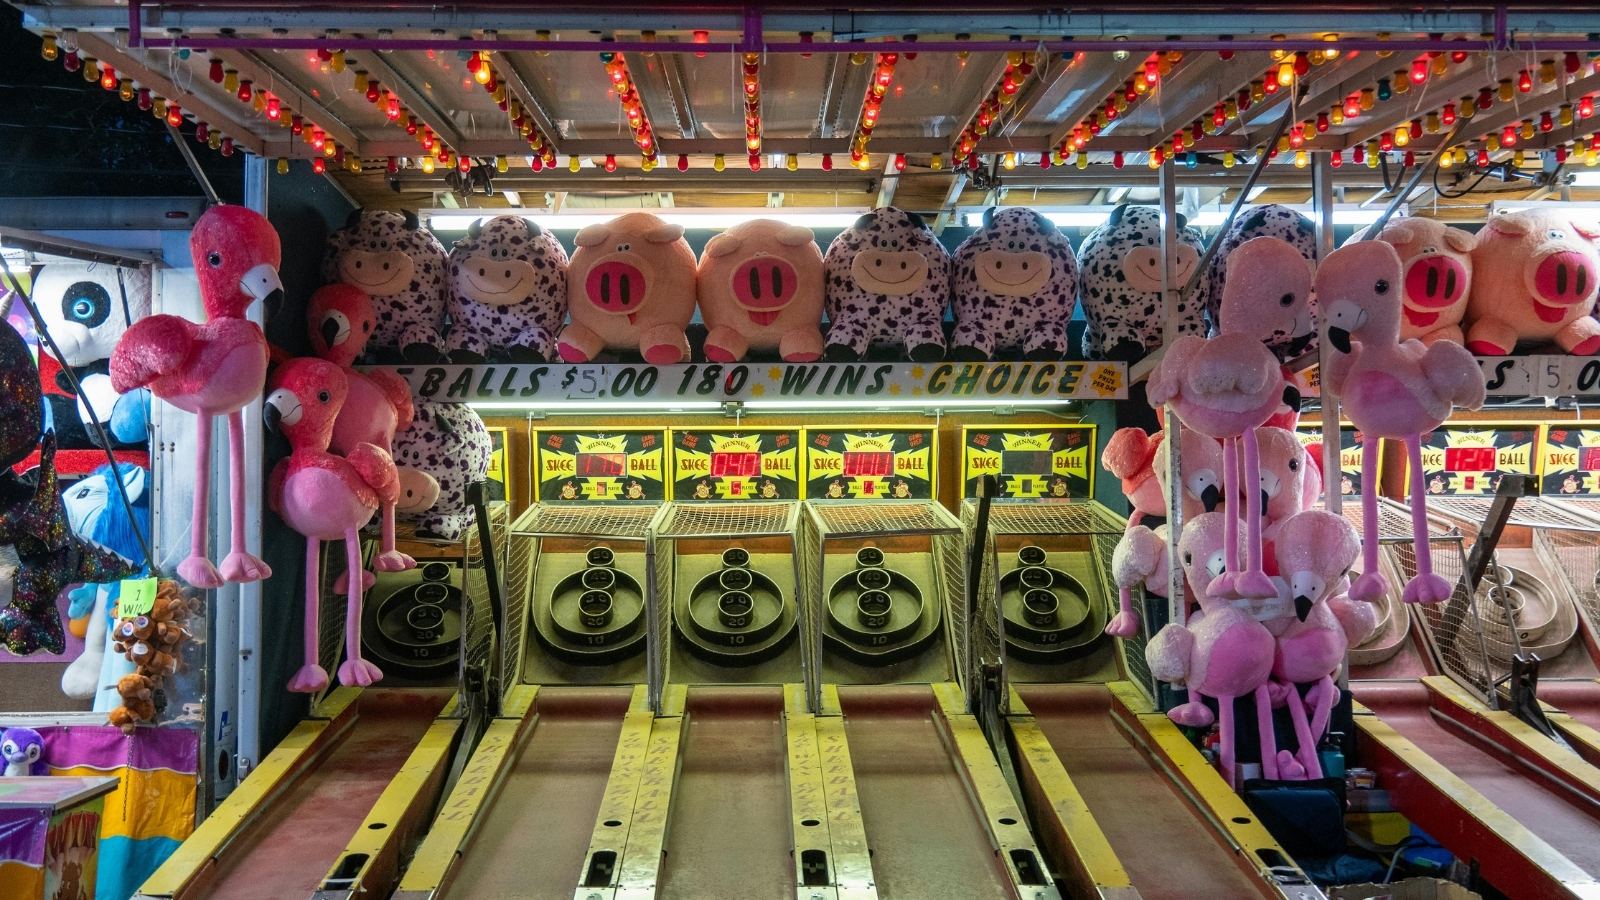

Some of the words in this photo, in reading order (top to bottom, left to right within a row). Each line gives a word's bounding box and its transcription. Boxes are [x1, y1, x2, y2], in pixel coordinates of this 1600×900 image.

[1102, 368, 1116, 377] ONE
[419, 367, 549, 398] BALLS
[677, 365, 749, 396] 180
[780, 365, 893, 396] WINS
[927, 364, 1085, 395] CHOICE
[1097, 374, 1116, 385] PRIZE
[1092, 380, 1105, 389] PER
[1104, 384, 1117, 393] DAY
[586, 441, 617, 450] WINNER
[721, 440, 751, 450] WINNER
[854, 440, 884, 449] WINNER
[1012, 439, 1042, 448] WINNER
[972, 457, 999, 469] SKEE
[1056, 457, 1082, 468] BALL
[1341, 454, 1362, 466] BAL
[1421, 454, 1442, 466] KEE
[1499, 453, 1525, 465] BALL
[1550, 453, 1576, 465] SKEE
[546, 460, 573, 471] SKEE
[631, 459, 657, 470] BALL
[681, 459, 708, 470] SKEE
[765, 458, 791, 470] BALL
[813, 458, 840, 470] SKEE
[898, 458, 924, 470] BALL
[593, 550, 609, 559] 50
[728, 551, 745, 560] 50
[860, 551, 876, 560] 50
[1021, 550, 1038, 558] 50
[586, 594, 607, 603] 30
[726, 595, 747, 604] 30
[863, 594, 885, 603] 30
[1029, 593, 1049, 602] 30
[587, 617, 604, 626] 20
[728, 617, 745, 626] 20
[868, 617, 885, 626] 20
[1035, 616, 1053, 625] 20
[417, 631, 434, 639] 20
[588, 635, 604, 644] 10
[730, 635, 745, 644] 10
[872, 635, 888, 644] 10
[1041, 633, 1058, 642] 10
[413, 649, 429, 657] 10
